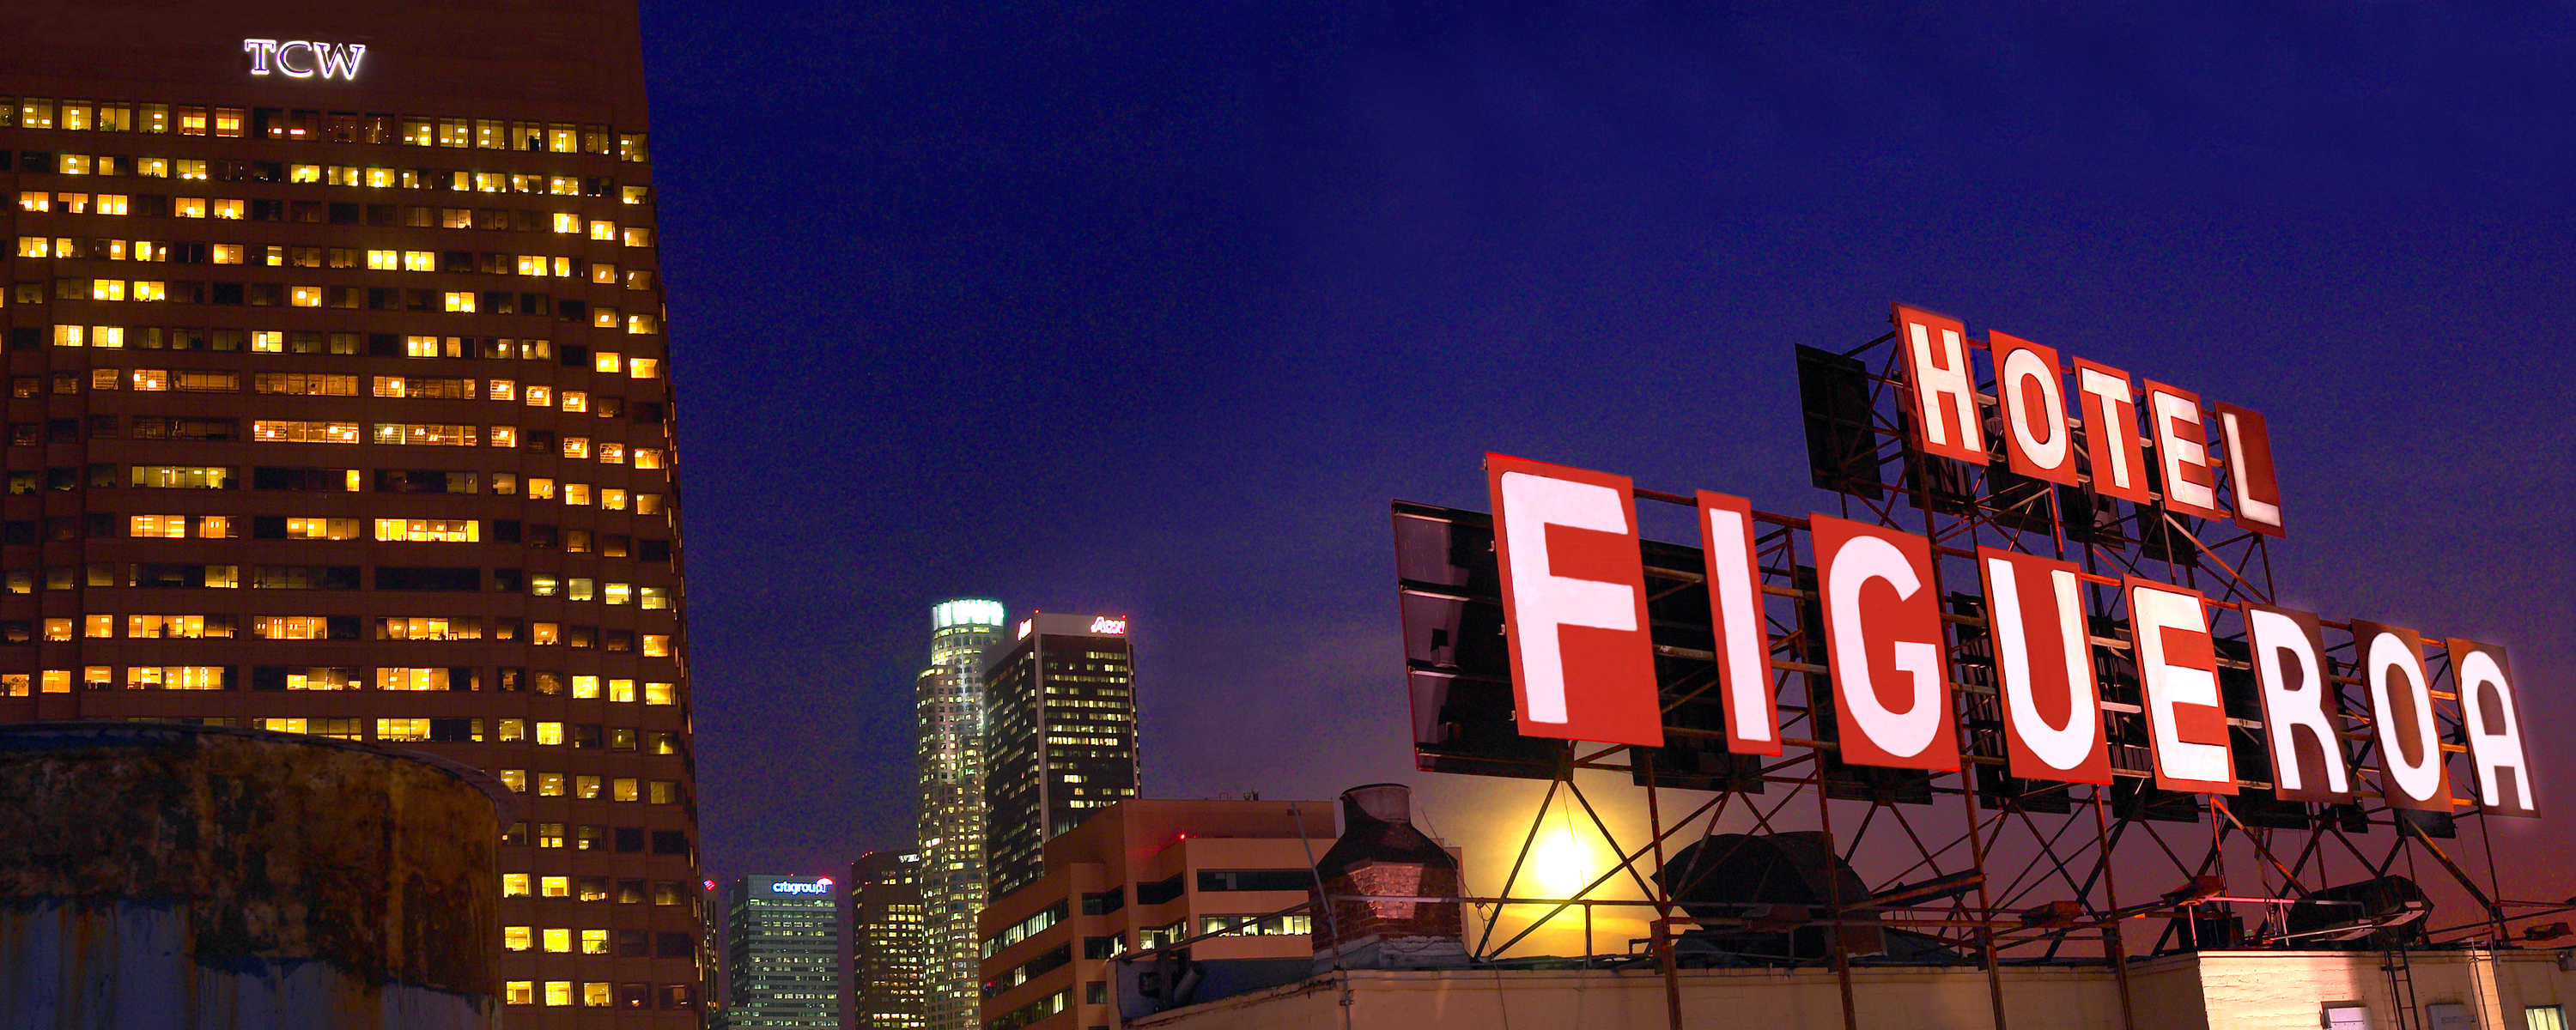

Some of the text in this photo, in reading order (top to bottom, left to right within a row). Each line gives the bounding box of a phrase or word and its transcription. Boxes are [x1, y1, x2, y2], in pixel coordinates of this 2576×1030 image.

[244, 39, 366, 80] TCW
[1909, 321, 2281, 528] HOTEL
[1500, 470, 2535, 811] FIGUEROA
